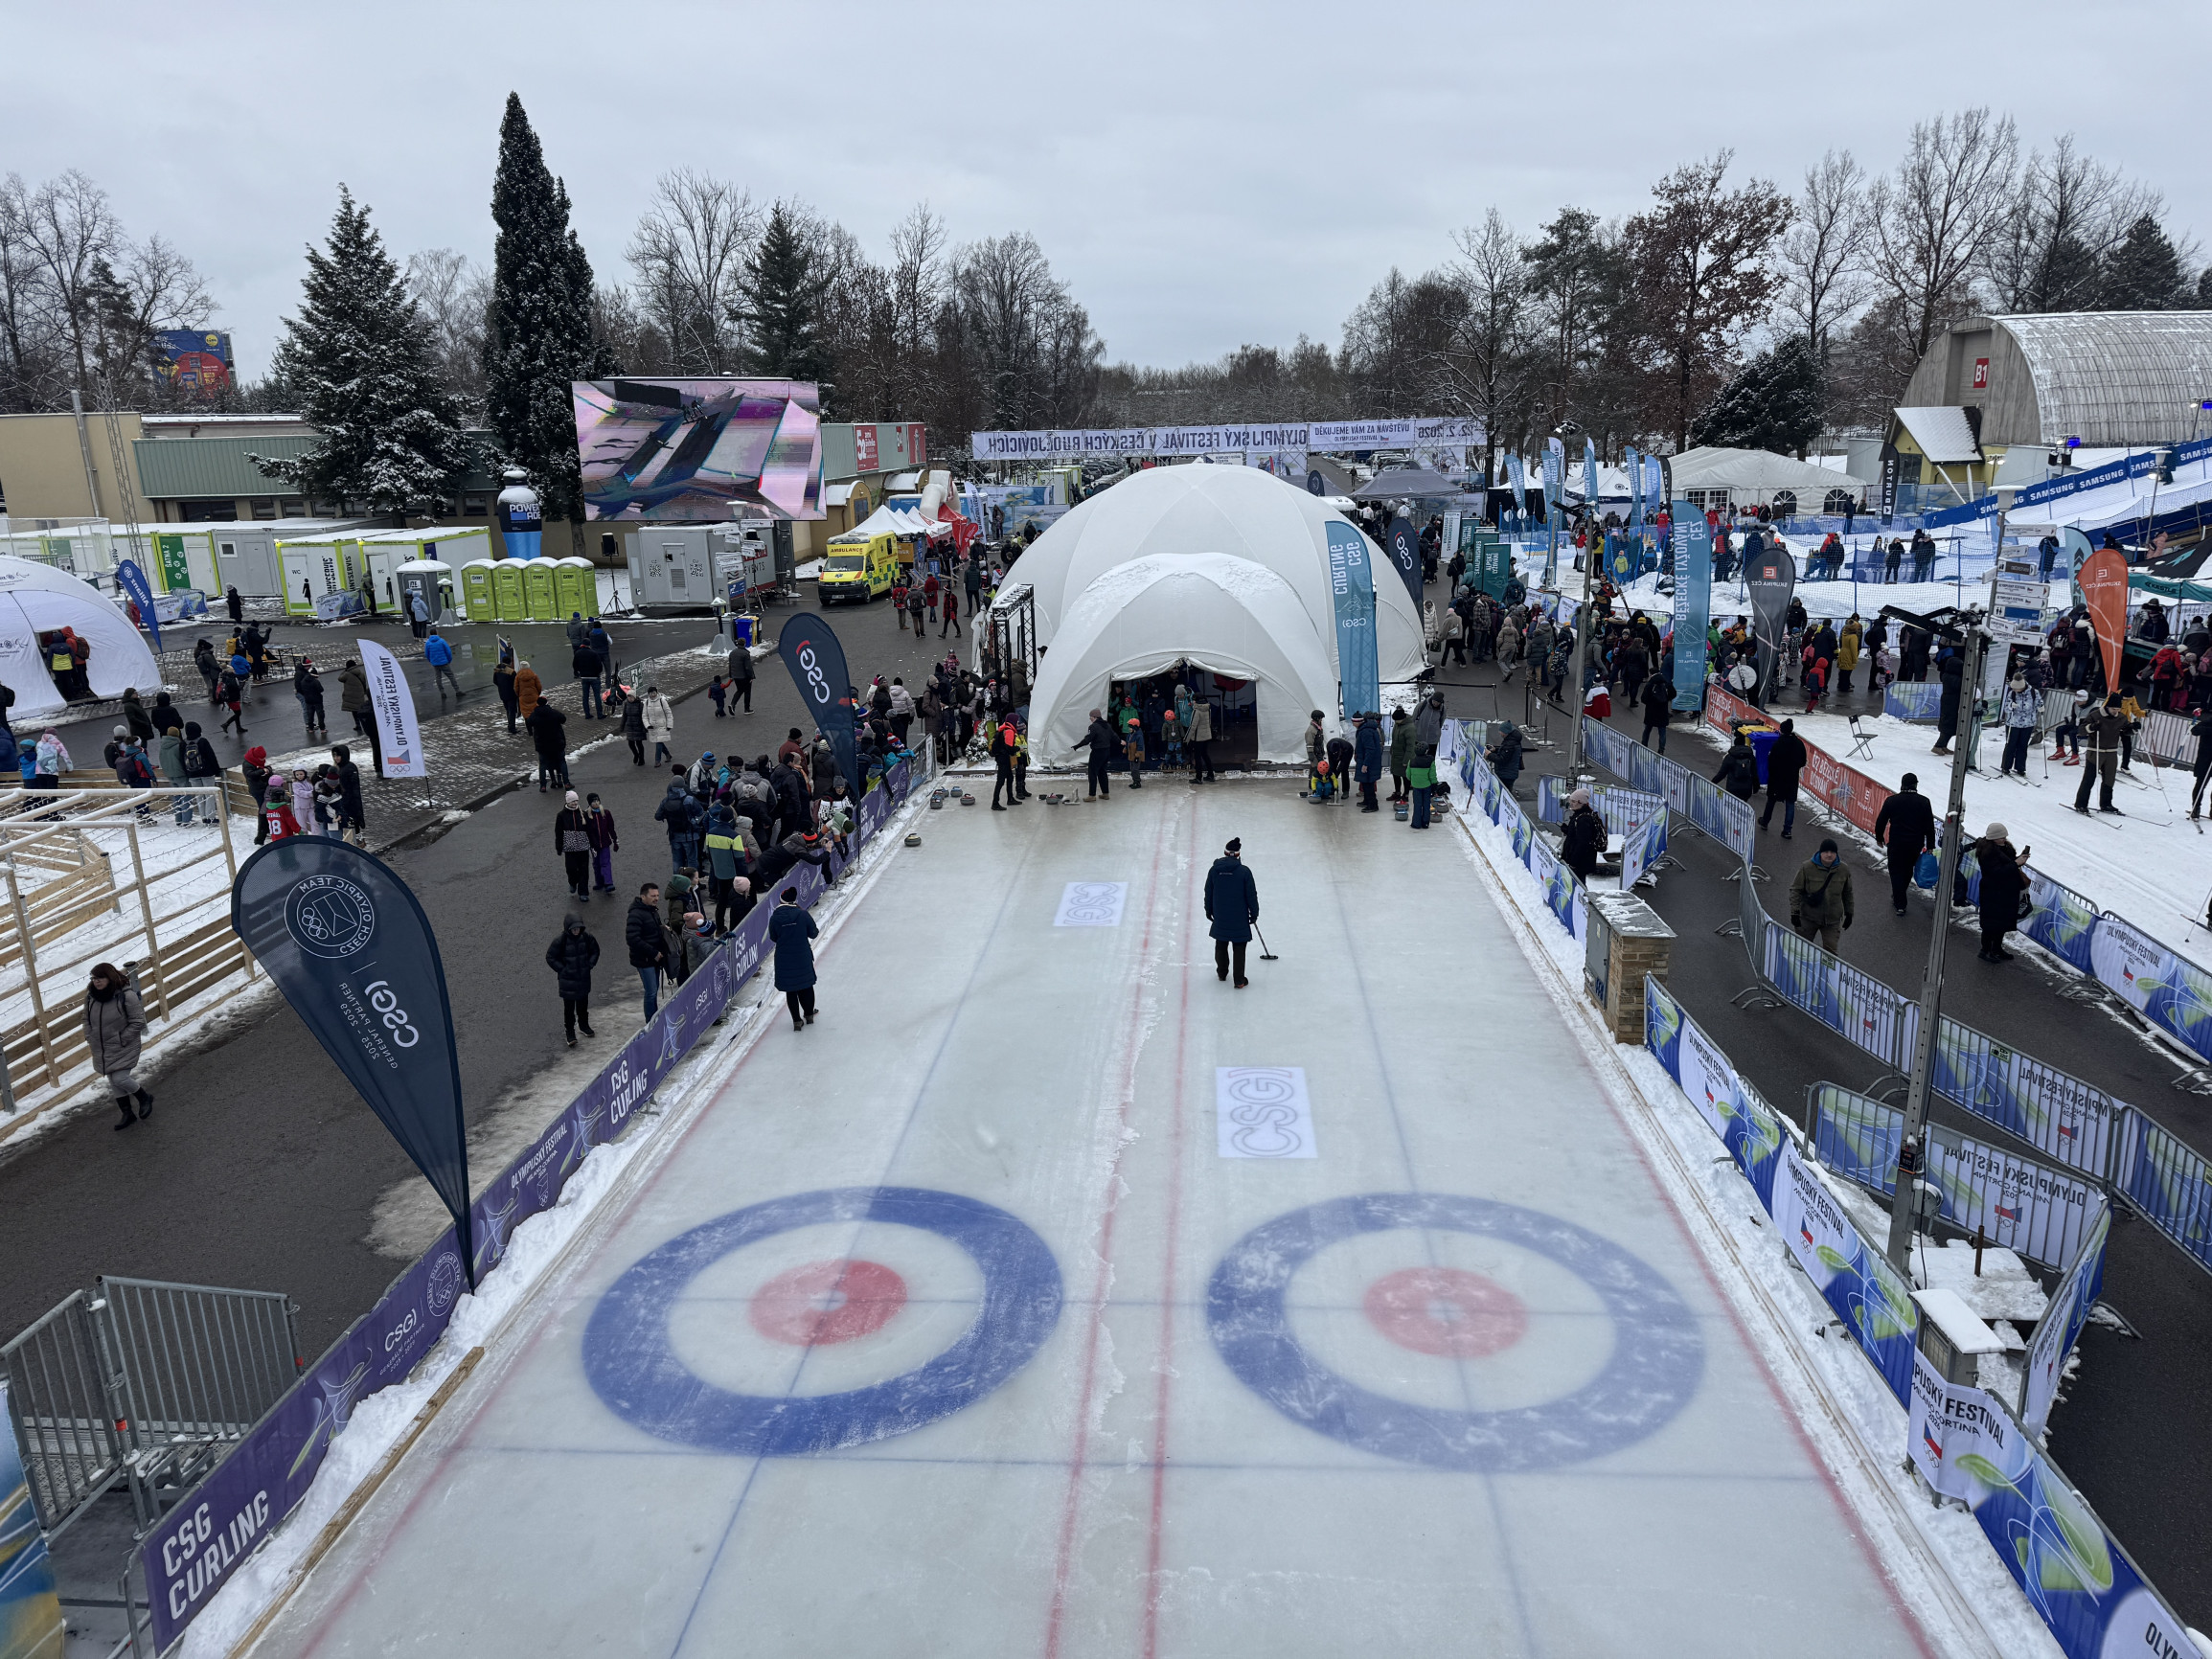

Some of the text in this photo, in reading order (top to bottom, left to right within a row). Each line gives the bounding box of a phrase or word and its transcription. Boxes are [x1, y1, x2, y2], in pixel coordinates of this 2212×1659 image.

[1974, 363, 1988, 382] B1
[1314, 424, 1350, 436] DĚKUJEME
[1351, 423, 1365, 434] VÁM
[1366, 424, 1376, 434] ZA
[2180, 446, 2212, 462] SAMSU
[2131, 460, 2155, 473] SAMS
[2079, 469, 2124, 489] SAMSUNG
[2029, 482, 2075, 501] SAMSUNG
[1979, 495, 2025, 514] SAMNG
[2137, 944, 2160, 968] FESTIVAL
[1713, 1057, 1731, 1092] FESTIVAL
[1228, 1077, 1302, 1157] CSG
[511, 1122, 568, 1189] OLYMPIJSKÝ FESTIVAL
[1817, 1189, 1844, 1239] FESTIVAL
[403, 1323, 425, 1347] PARTNER
[1911, 1382, 1981, 1439] MILANO CORTINA
[1914, 1361, 2004, 1450] PIJSKÝ FESTIVAL
[1927, 1411, 1941, 1431] 2026
[162, 1501, 213, 1578] CSG
[168, 1489, 270, 1622] CURLING
